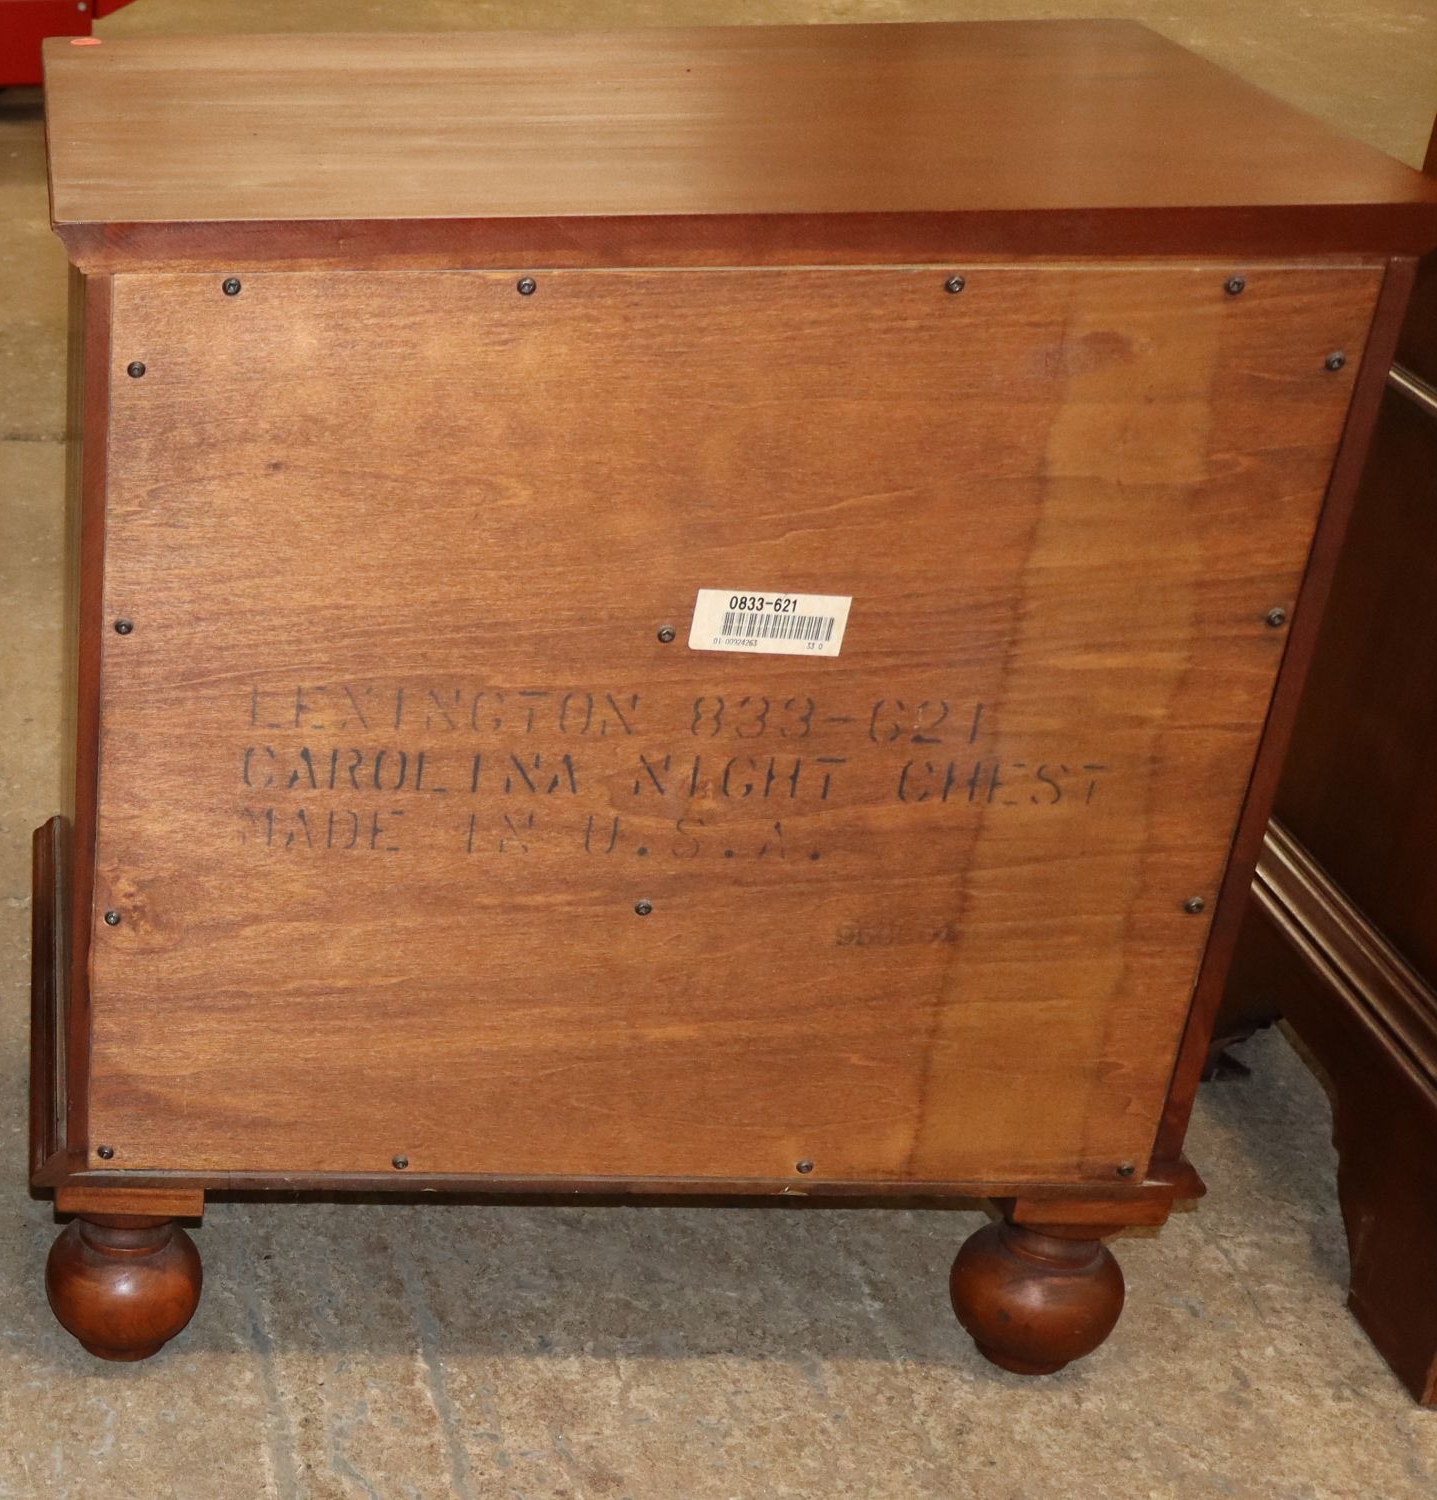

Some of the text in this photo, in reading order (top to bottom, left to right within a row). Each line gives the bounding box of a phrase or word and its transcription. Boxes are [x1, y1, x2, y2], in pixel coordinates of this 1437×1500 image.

[730, 596, 797, 612] 0833-621
[249, 686, 983, 744] LEXINGTON 833-621
[243, 747, 1105, 805] CAROLINA NIGHT CHEST
[236, 806, 404, 852] MADE
[468, 813, 535, 854] IN
